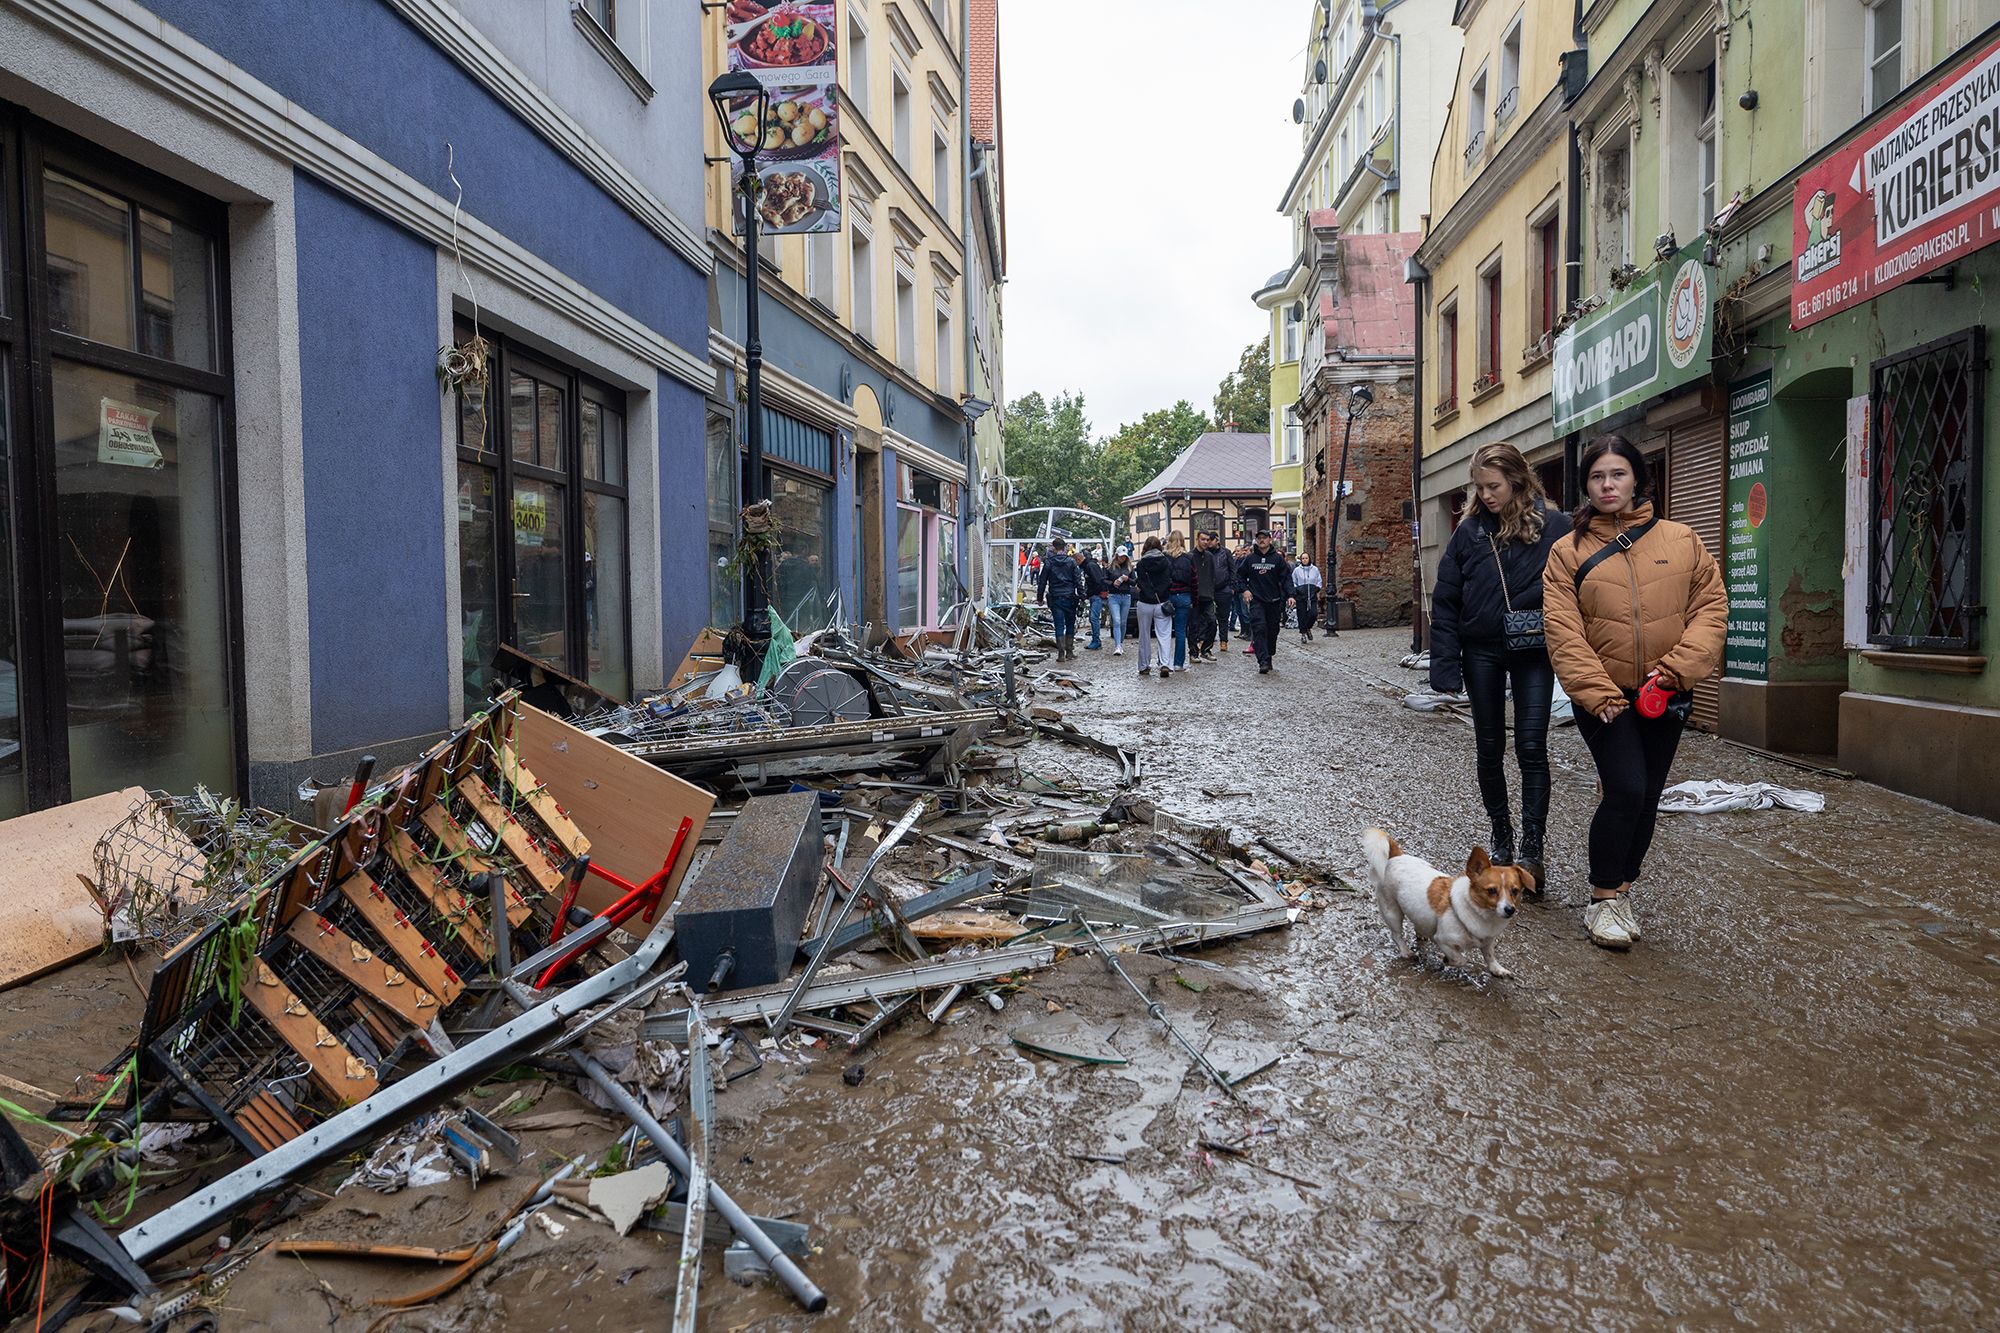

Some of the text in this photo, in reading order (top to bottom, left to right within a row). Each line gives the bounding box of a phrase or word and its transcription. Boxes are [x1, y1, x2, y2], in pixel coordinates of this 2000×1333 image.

[756, 69, 829, 84] mowego Gara
[1871, 62, 2000, 179] NAJTAŃSZE PRZESYŁKI
[1797, 230, 1841, 281] pakersi
[1797, 300, 1811, 320] TEL:
[1812, 291, 1825, 313] 667
[1826, 284, 1841, 306] 916
[1842, 276, 1858, 300] 214
[1874, 222, 1970, 285] KLODZKO@PAKERSI.PL
[1558, 313, 1651, 405] LOOMBARD
[1732, 387, 1768, 410] LOOMBARD
[107, 416, 147, 431] PARKOWANIA
[115, 410, 140, 423] ZAKAZ
[1730, 420, 1750, 440] SKUP
[1729, 431, 1769, 460] SPRZEDAŻ
[1729, 458, 1764, 480] ZAMIANA
[515, 512, 541, 532] 3400
[1731, 517, 1748, 529] srebro
[1731, 532, 1753, 545] biżuteria
[1731, 548, 1757, 563] sprzęt RTV
[1730, 564, 1758, 579] sprzęt AGD
[1730, 581, 1758, 595] samochody
[1730, 596, 1766, 609] nieruchomości
[1736, 621, 1742, 631] 74
[1751, 621, 1758, 631] 02
[1758, 621, 1765, 632] 42
